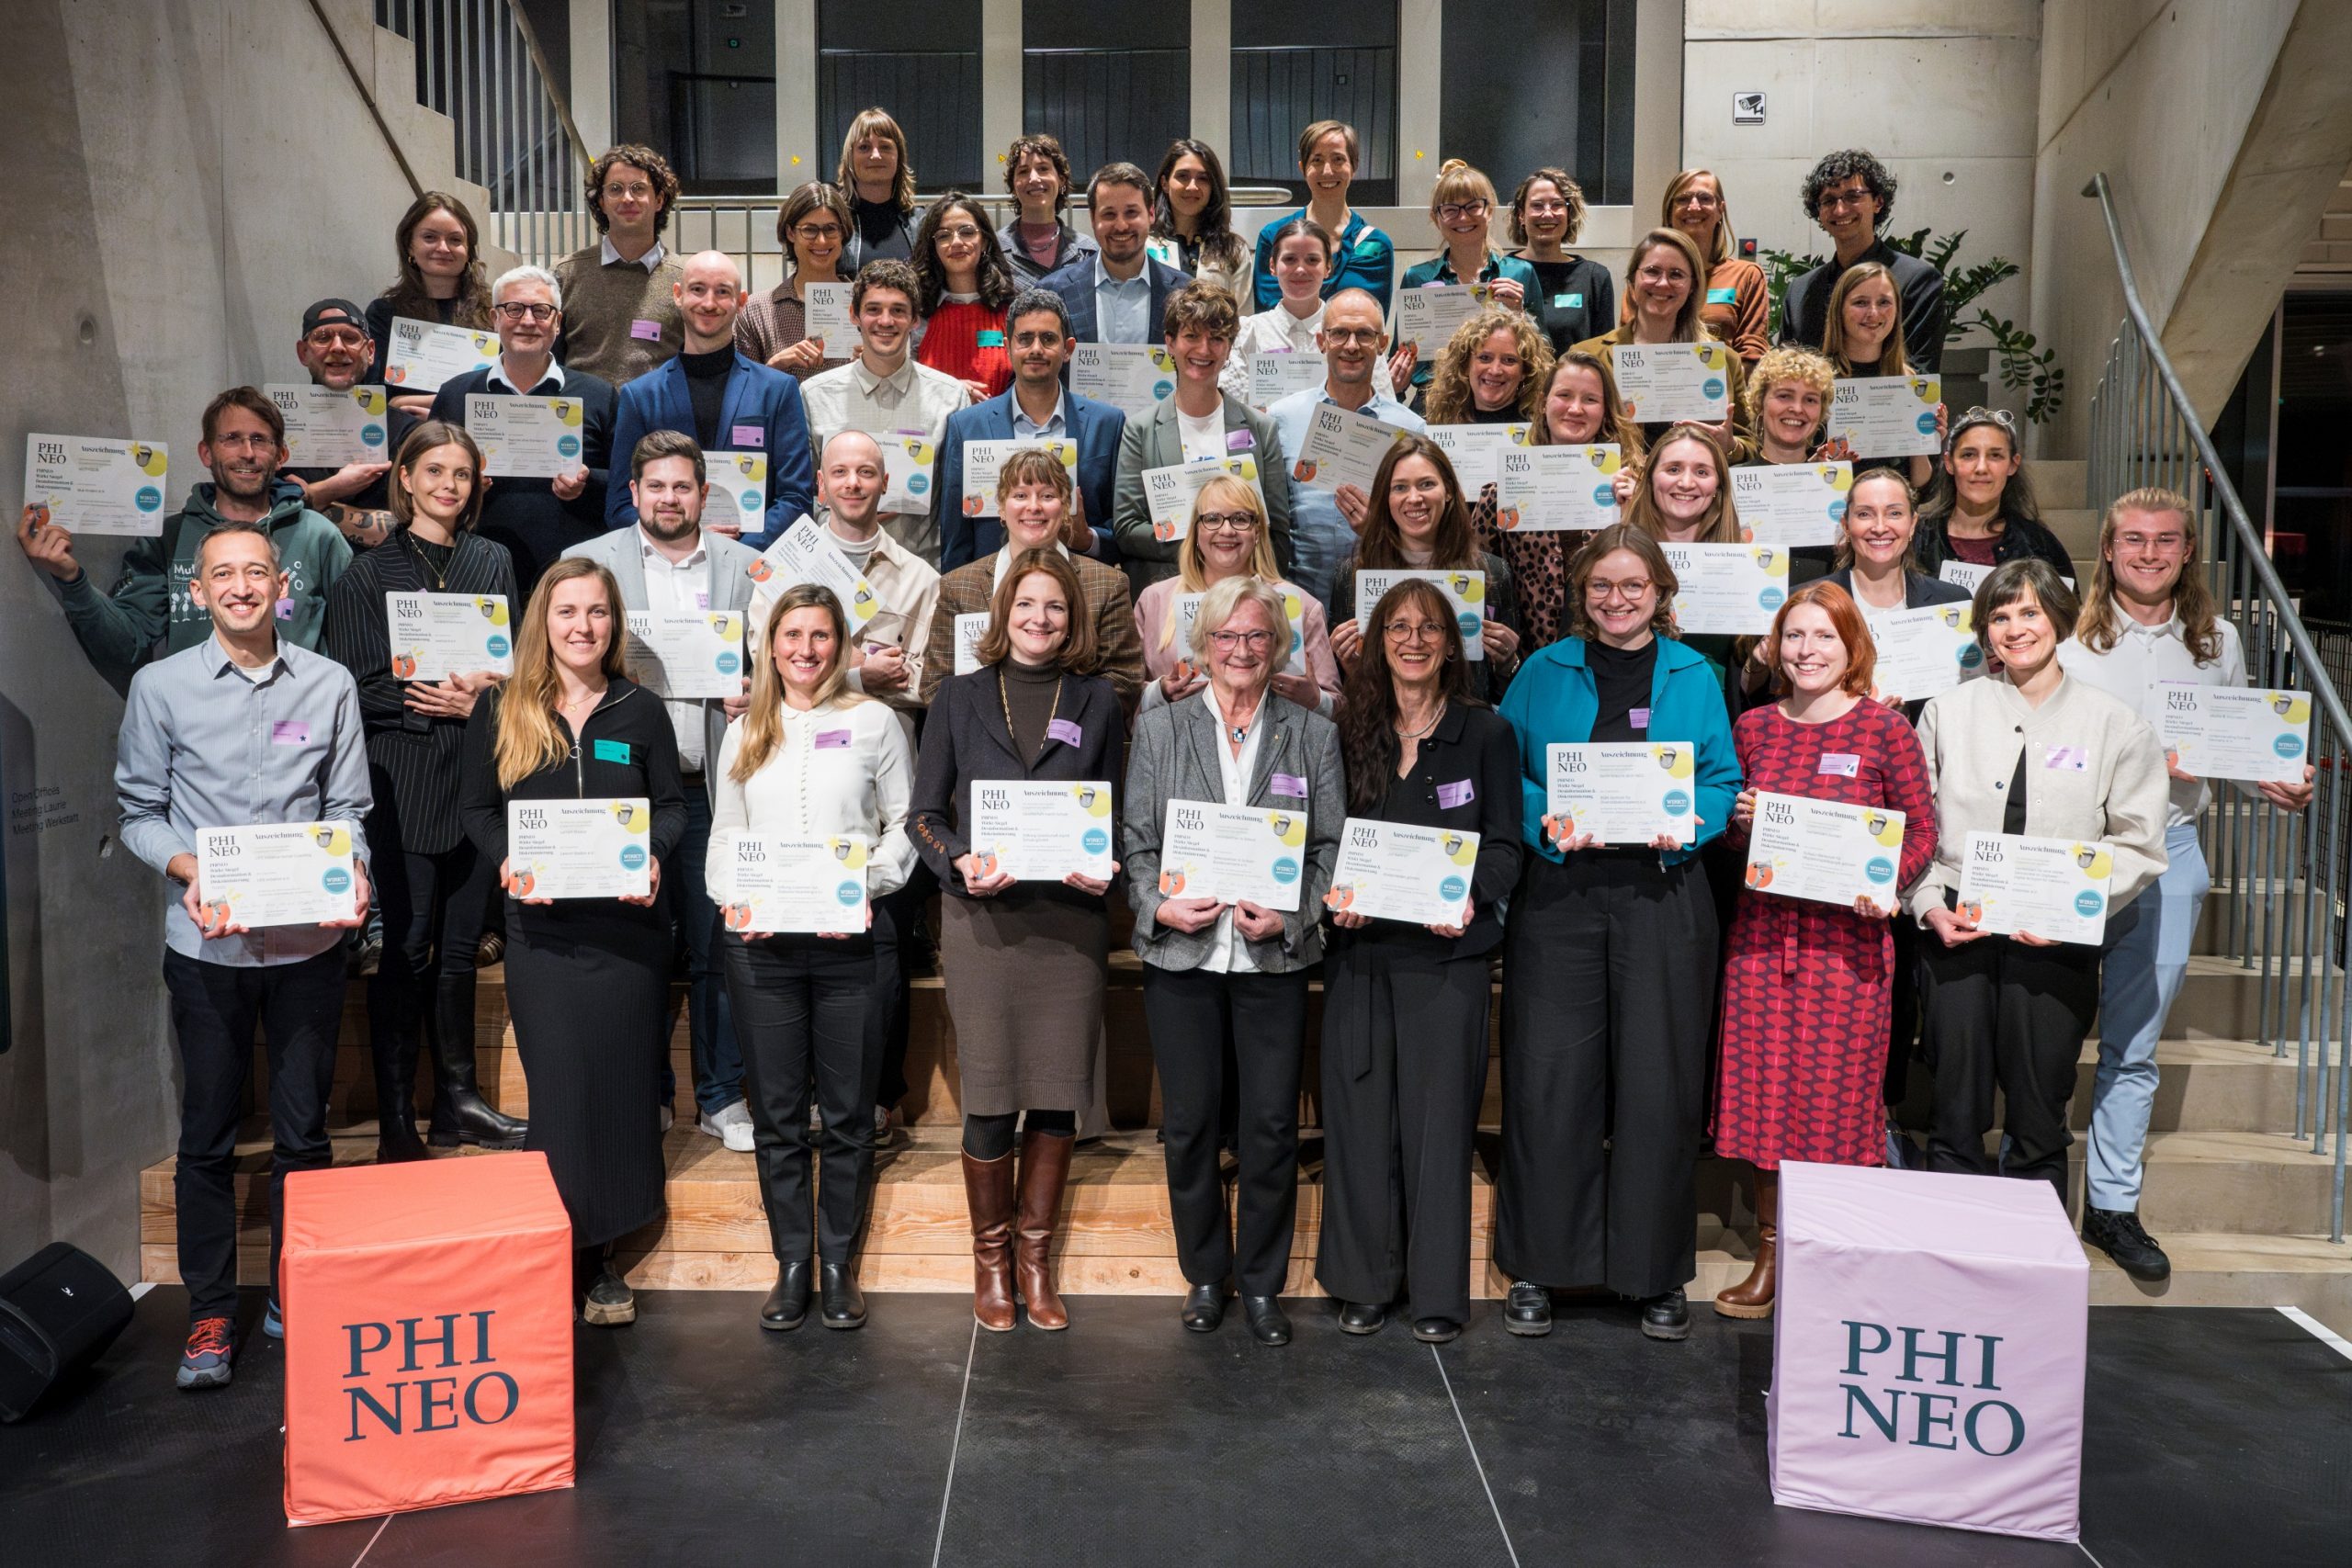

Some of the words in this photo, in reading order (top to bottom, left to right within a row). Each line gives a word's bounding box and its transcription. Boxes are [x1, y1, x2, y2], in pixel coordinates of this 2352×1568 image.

[813, 297, 834, 305] NEO
[1404, 295, 1422, 303] PHI
[1404, 302, 1425, 310] NEO
[400, 323, 419, 333] PHI
[399, 331, 422, 341] NEO
[1078, 349, 1097, 357] PHI
[1622, 352, 1641, 360] PHI
[1078, 358, 1100, 367] NEO
[1256, 359, 1276, 367] PHI
[1622, 359, 1645, 367] NEO
[1256, 367, 1278, 376] NEO
[1836, 386, 1855, 394] PHI
[273, 391, 294, 400] PHI
[1836, 394, 1859, 403] NEO
[473, 401, 494, 410] PHI
[473, 409, 498, 419] NEO
[1321, 411, 1342, 423] PHI
[1318, 419, 1341, 433] NEO
[1433, 432, 1453, 440] PHI
[38, 443, 63, 454] PHI
[81, 446, 126, 456] Auszeichnung
[972, 447, 991, 456] PHI
[37, 453, 67, 465] NEO
[972, 455, 995, 463] NEO
[1506, 455, 1526, 464] PHI
[1506, 463, 1531, 472] NEO
[1151, 473, 1172, 482] PHI
[1736, 474, 1758, 482] PHI
[1153, 480, 1176, 491] NEO
[1736, 481, 1762, 491] NEO
[799, 525, 819, 545] PHI
[795, 535, 814, 553] NEO
[1669, 560, 1690, 570] EO
[1951, 569, 1973, 579] PHI
[1365, 578, 1386, 586] PHI
[396, 600, 418, 609] PHI
[1183, 602, 1200, 610] PH
[397, 609, 423, 618] NEO
[627, 618, 648, 627] PHI
[964, 629, 979, 638] NE
[2167, 692, 2194, 702] PHI
[2212, 694, 2262, 703] Auszeichnung
[2167, 701, 2198, 711] NEO
[1557, 752, 1582, 762] PHI
[1557, 761, 1587, 773] NEO
[12, 792, 32, 805] Open
[34, 786, 61, 799] Offices
[982, 790, 1006, 799] PHI
[12, 807, 42, 818] Meeting
[44, 801, 67, 813] Laurie
[982, 800, 1010, 810] NEO
[1767, 801, 1792, 815] PHI
[519, 809, 544, 819] PHI
[1177, 808, 1201, 819] PHI
[1218, 812, 1263, 823] Auszeichnung
[1764, 812, 1794, 825] NEO
[1810, 807, 1857, 821] Auszeichnung
[12, 822, 44, 835] Meeting
[45, 813, 79, 829] Werkstatt
[519, 819, 548, 829] NEO
[1176, 818, 1204, 830] NEO
[254, 831, 303, 840] Auszeichnung
[1352, 827, 1376, 838] PHI
[1393, 831, 1435, 842] Auszeichnung
[209, 836, 235, 846] PHI
[1351, 837, 1378, 849] NEO
[1976, 840, 2001, 852] PHI
[209, 846, 240, 857] NEO
[739, 842, 762, 851] PHI
[2019, 845, 2066, 855] Auszeichnung
[738, 852, 766, 862] NEO
[1973, 851, 2003, 863] NEO
[342, 1310, 496, 1379] PHI
[1839, 1320, 2004, 1392] PHI
[343, 1371, 519, 1442] NEO
[1838, 1383, 2025, 1457] NEO
